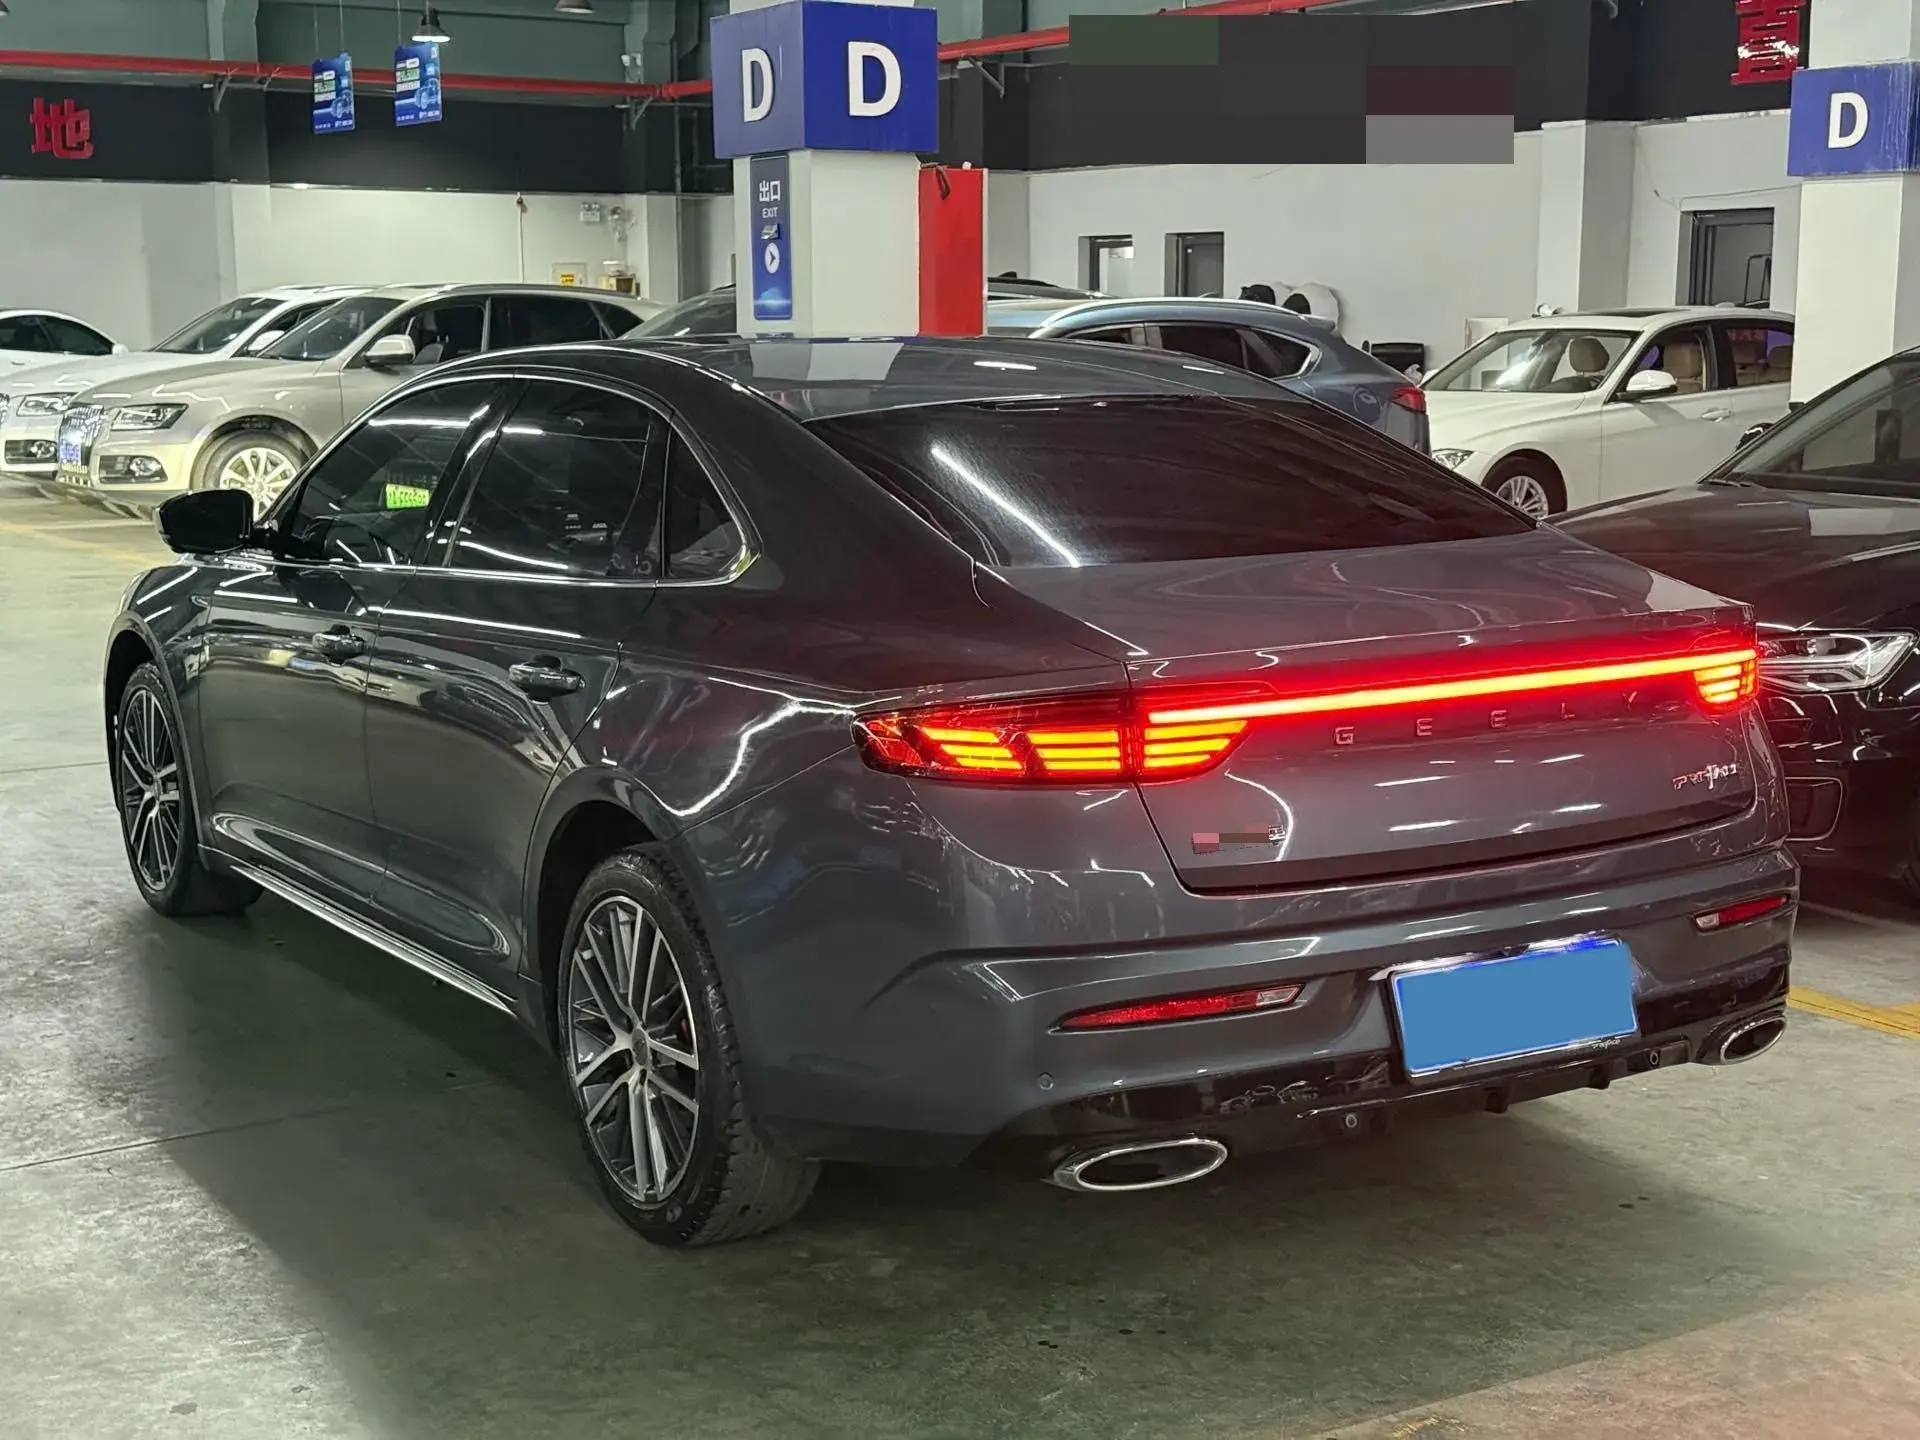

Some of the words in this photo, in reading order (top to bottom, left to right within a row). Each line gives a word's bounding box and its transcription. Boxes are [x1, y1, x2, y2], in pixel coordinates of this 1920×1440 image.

[742, 48, 774, 122] D
[848, 41, 901, 117] D
[30, 97, 95, 159] 地
[1828, 92, 1868, 149] D
[759, 180, 780, 201] 出口
[762, 206, 778, 218] EXIT
[1334, 691, 1639, 746] GEELY
